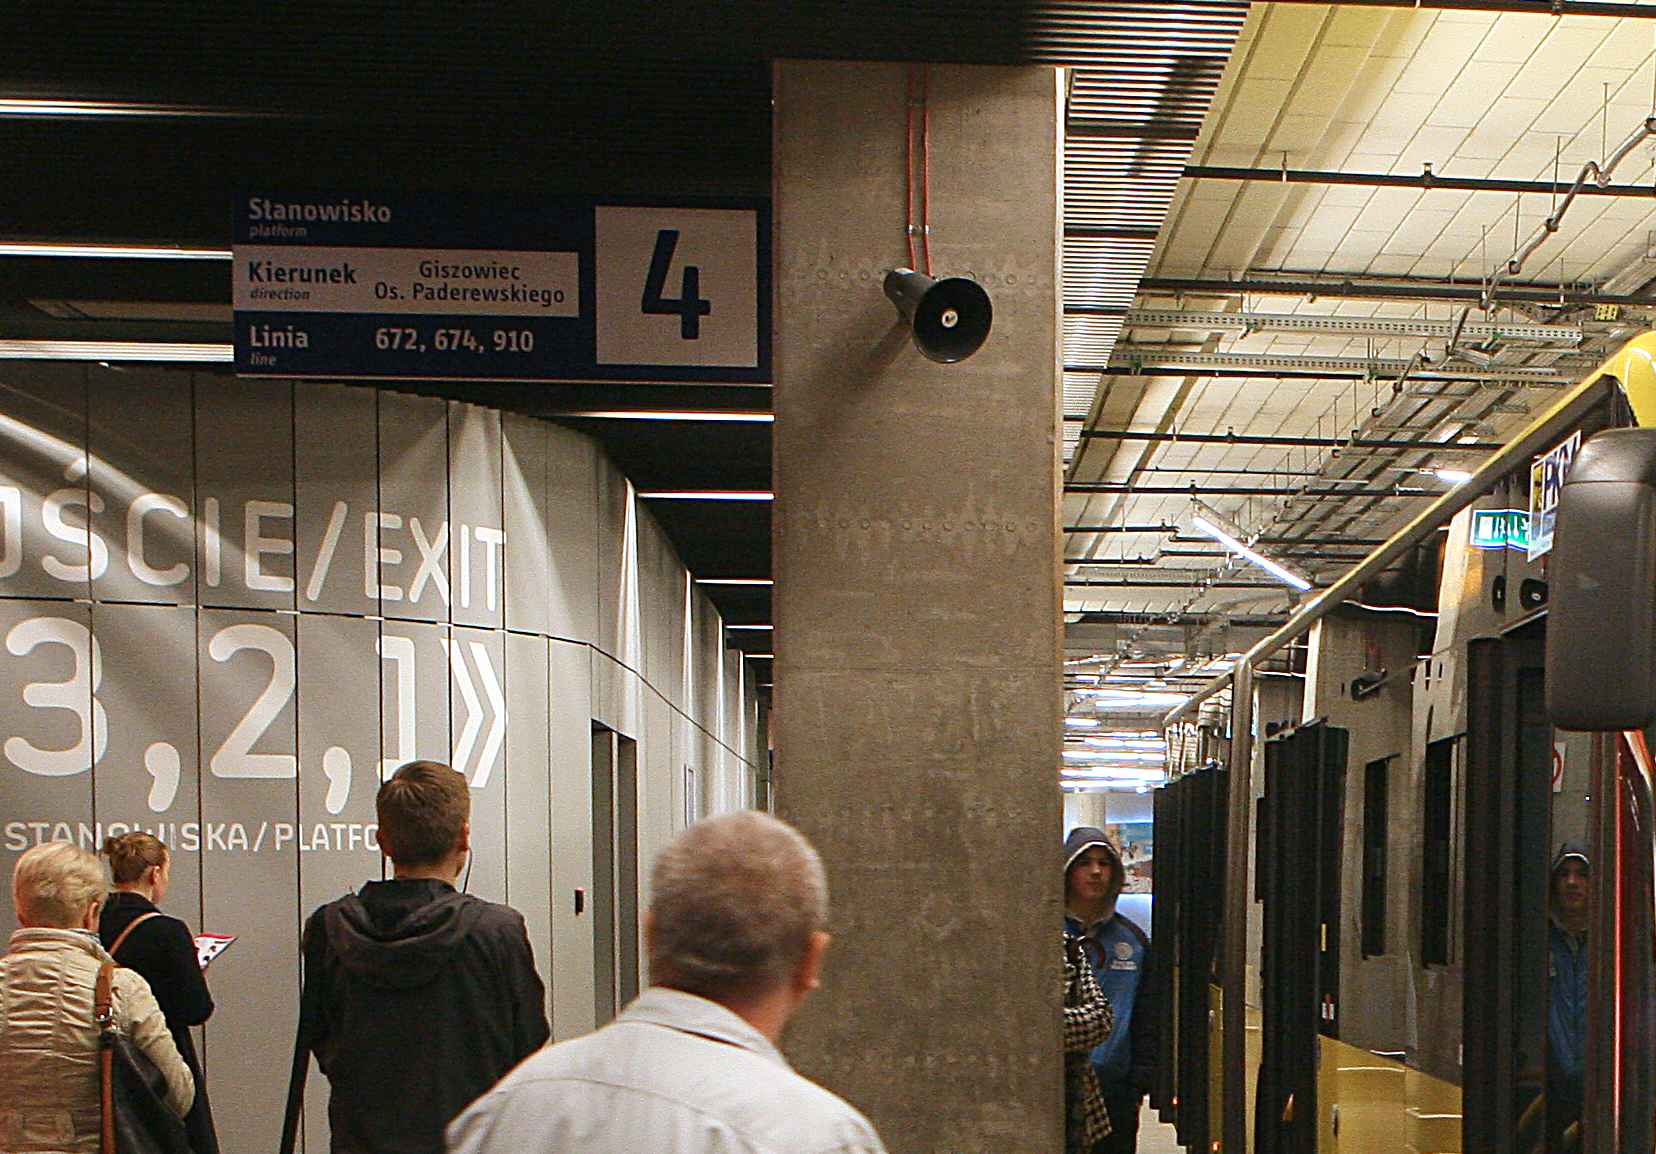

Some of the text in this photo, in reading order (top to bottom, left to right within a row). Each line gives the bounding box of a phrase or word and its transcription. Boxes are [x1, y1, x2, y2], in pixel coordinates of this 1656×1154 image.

[249, 198, 391, 222] Stanowisko
[250, 223, 308, 238] platform
[248, 261, 357, 284] Kierunek
[419, 260, 520, 280] Giszowiec
[250, 288, 310, 300] direction
[374, 281, 565, 307] Os. Paderewskiego
[641, 230, 711, 339] 4
[250, 324, 534, 354] Linia 672, 674, 910
[251, 353, 277, 365] line
